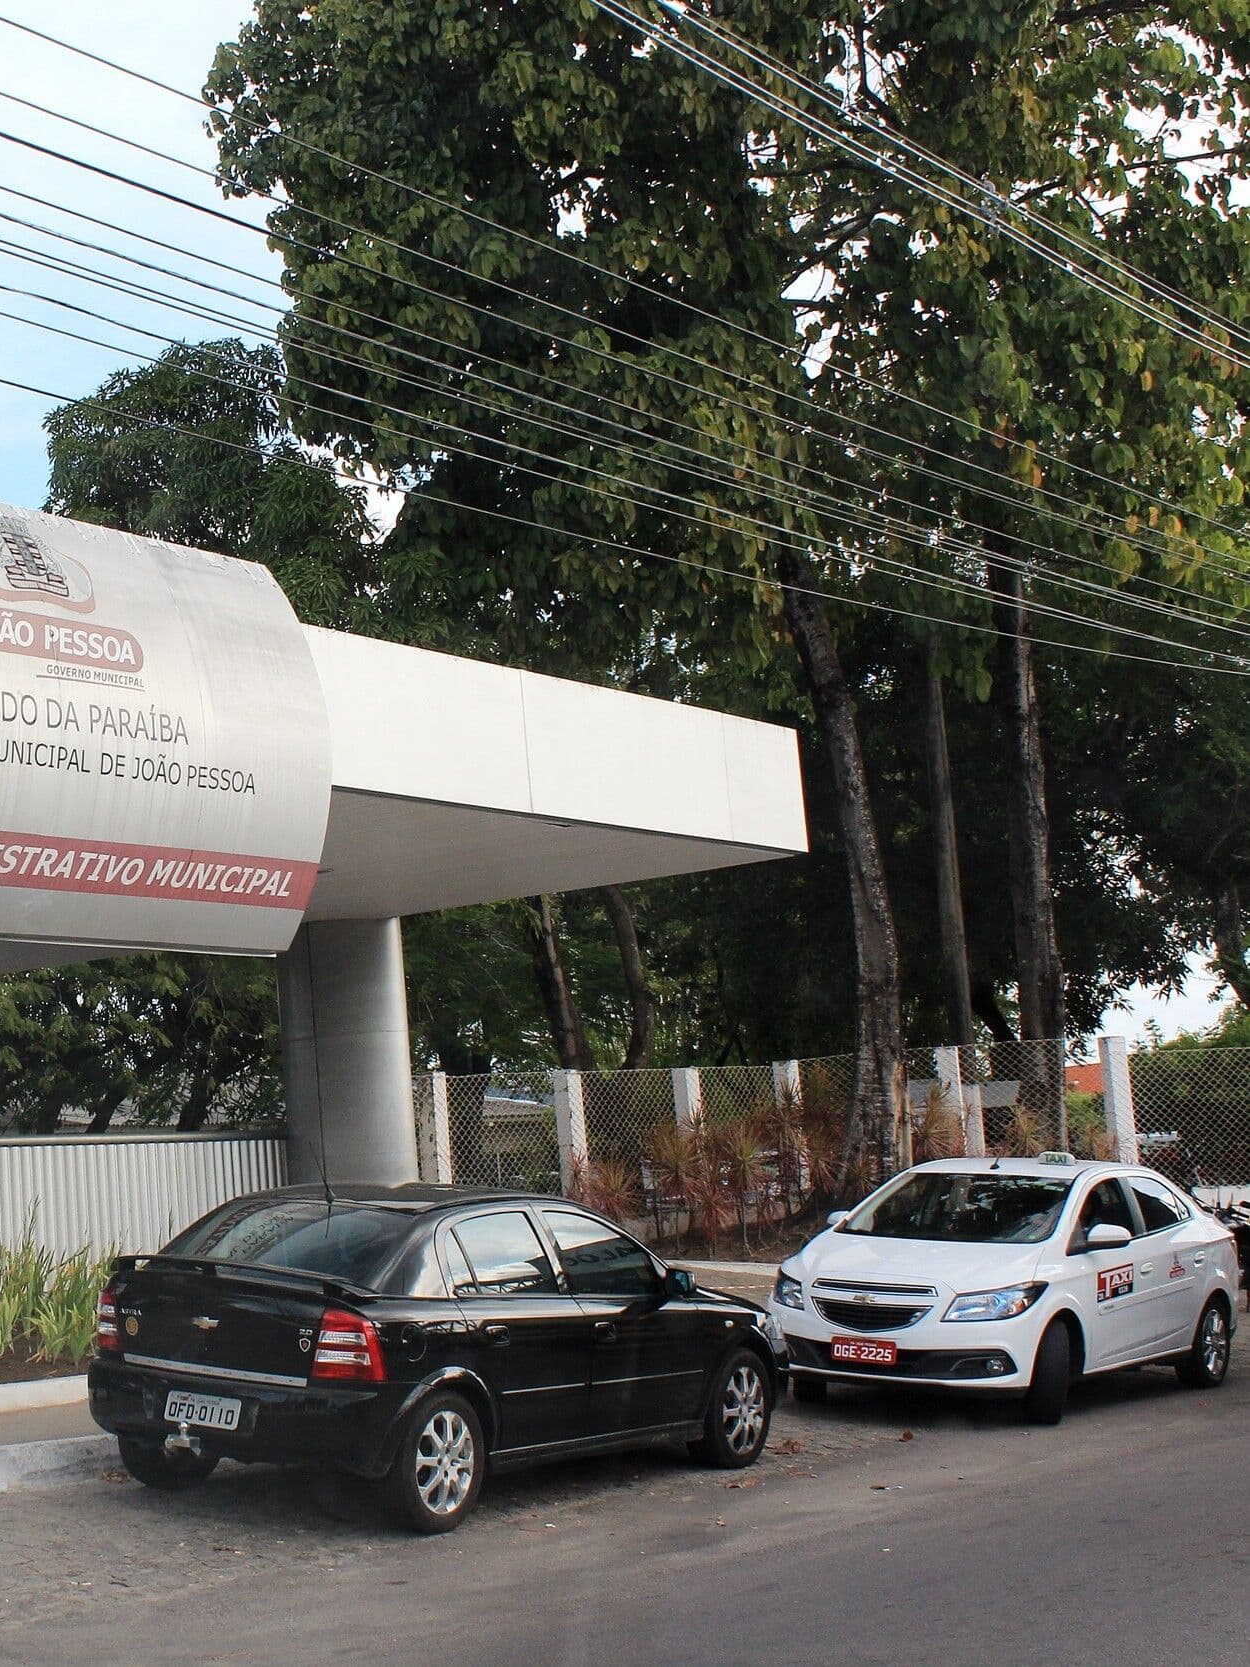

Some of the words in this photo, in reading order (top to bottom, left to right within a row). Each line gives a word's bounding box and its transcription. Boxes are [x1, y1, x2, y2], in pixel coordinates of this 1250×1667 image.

[44, 624, 136, 665] PESSOA
[46, 664, 91, 680] GOVERNO
[93, 671, 145, 688] MUNICIPAL
[46, 698, 80, 732] DA
[89, 704, 189, 745] PARAÍBA
[100, 752, 126, 778] DE
[132, 753, 181, 785] JOÃO
[187, 765, 255, 795] PESSOA
[146, 858, 293, 897] MUNICIPAL
[1044, 1153, 1067, 1164] TAXI
[1101, 1266, 1133, 1298] TAXI
